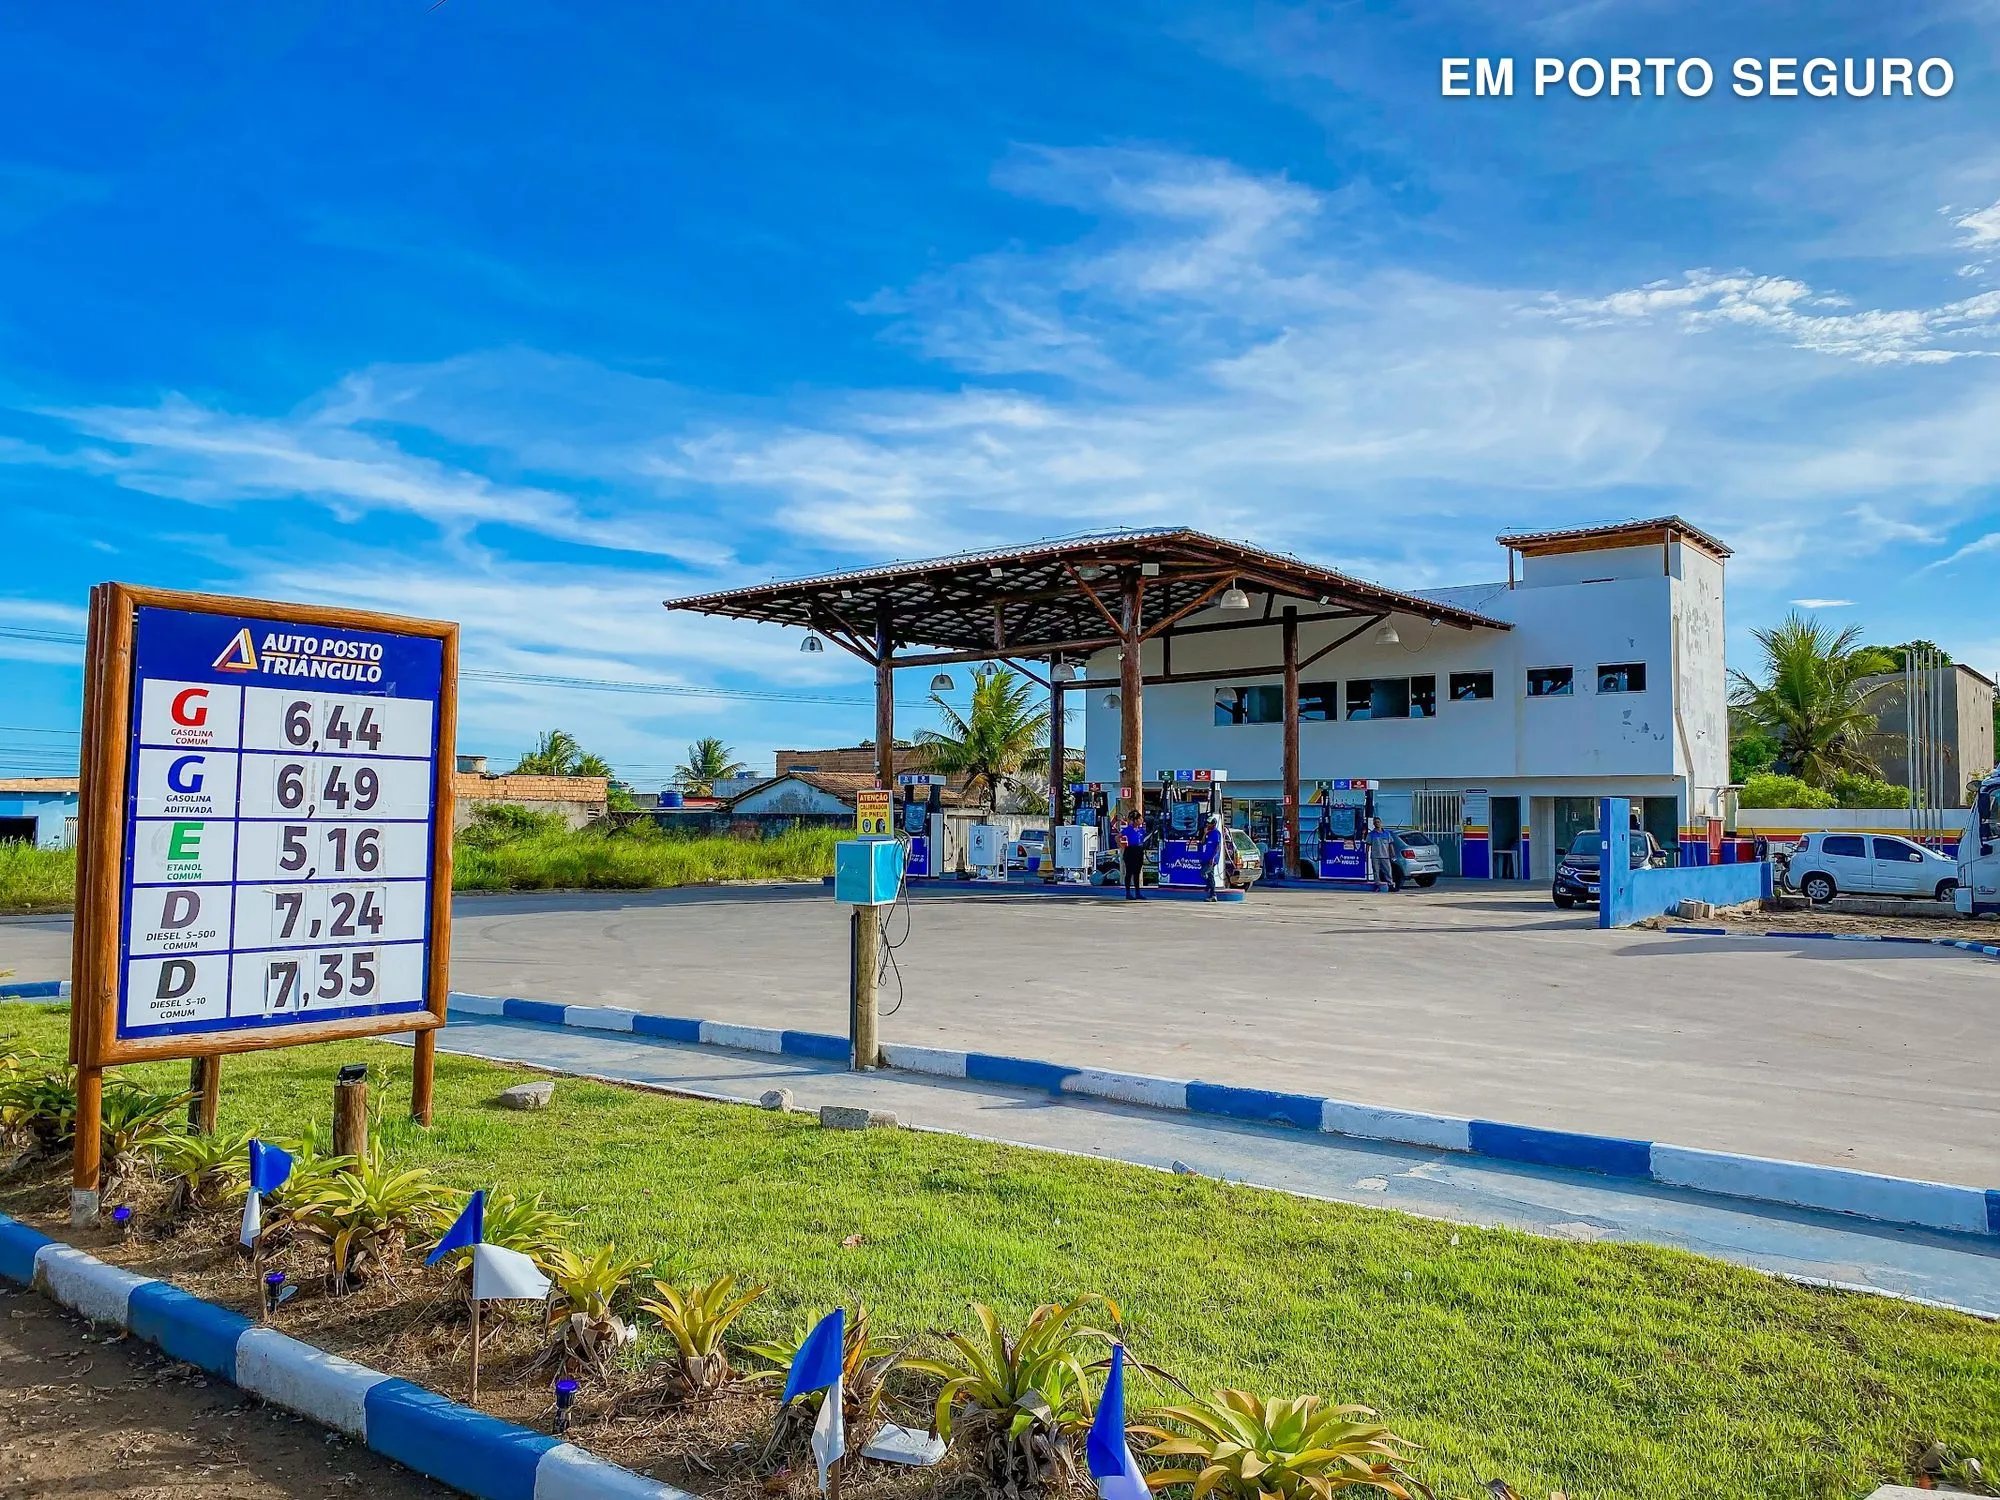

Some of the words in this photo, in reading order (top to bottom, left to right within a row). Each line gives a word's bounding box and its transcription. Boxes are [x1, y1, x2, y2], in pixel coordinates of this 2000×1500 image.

[262, 633, 318, 655] AUTO
[321, 640, 384, 661] POSTO
[260, 654, 383, 683] TRIÂNGULO
[171, 688, 210, 727] G
[170, 728, 214, 738] GASOLINA
[284, 701, 382, 752] 6,44
[175, 737, 208, 746] COMUM
[167, 755, 206, 794] G
[166, 794, 212, 803] GASOLINA
[277, 764, 379, 818] 6,49
[860, 793, 888, 802] ATENÇÃO
[163, 805, 213, 814] ADITIVADA
[167, 822, 205, 861] E
[279, 825, 380, 880] 5,16
[166, 863, 203, 872] ETANOL
[167, 872, 202, 881] COMUM
[160, 890, 201, 930] D
[275, 890, 383, 939] 7,24
[146, 932, 181, 942] DIESEL
[186, 930, 216, 940] S-500
[163, 941, 198, 951] COMUM
[156, 959, 196, 1000] D
[270, 951, 375, 1009] 7,35
[150, 1000, 182, 1009] DIESEL
[185, 997, 206, 1006] S-10
[160, 1009, 195, 1019] COMUM
